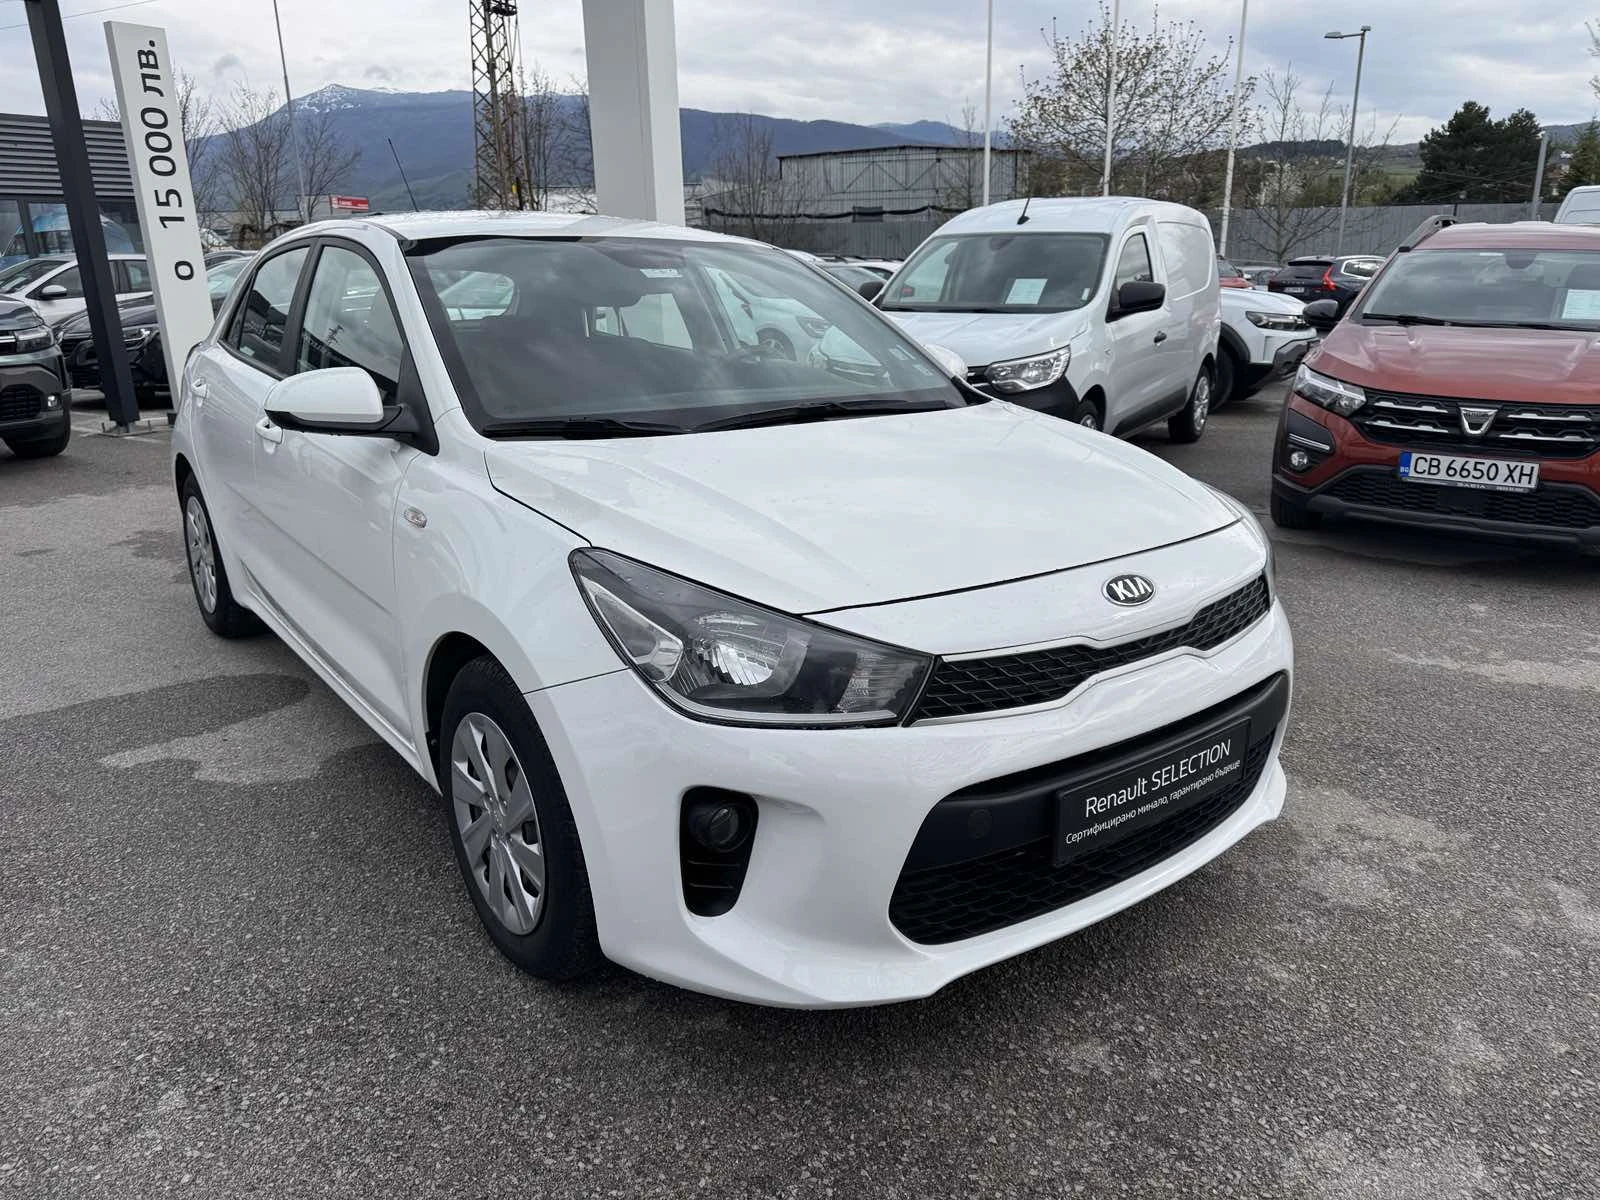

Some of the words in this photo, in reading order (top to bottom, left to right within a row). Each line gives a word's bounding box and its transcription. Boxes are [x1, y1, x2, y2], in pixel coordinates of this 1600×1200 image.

[137, 39, 165, 97] лв.
[140, 106, 177, 177] 000
[154, 188, 185, 229] 15
[1413, 456, 1441, 476] CB
[1445, 459, 1500, 481] 6650
[1503, 463, 1535, 485] XH
[1109, 576, 1152, 601] KIA
[1065, 809, 1137, 845] Сертифицирано
[1137, 796, 1169, 816] минало,
[1169, 773, 1215, 801] гарантирано
[1214, 759, 1241, 779] бъдеще
[1085, 777, 1148, 818] Renault
[1151, 738, 1231, 791] SELECTION
